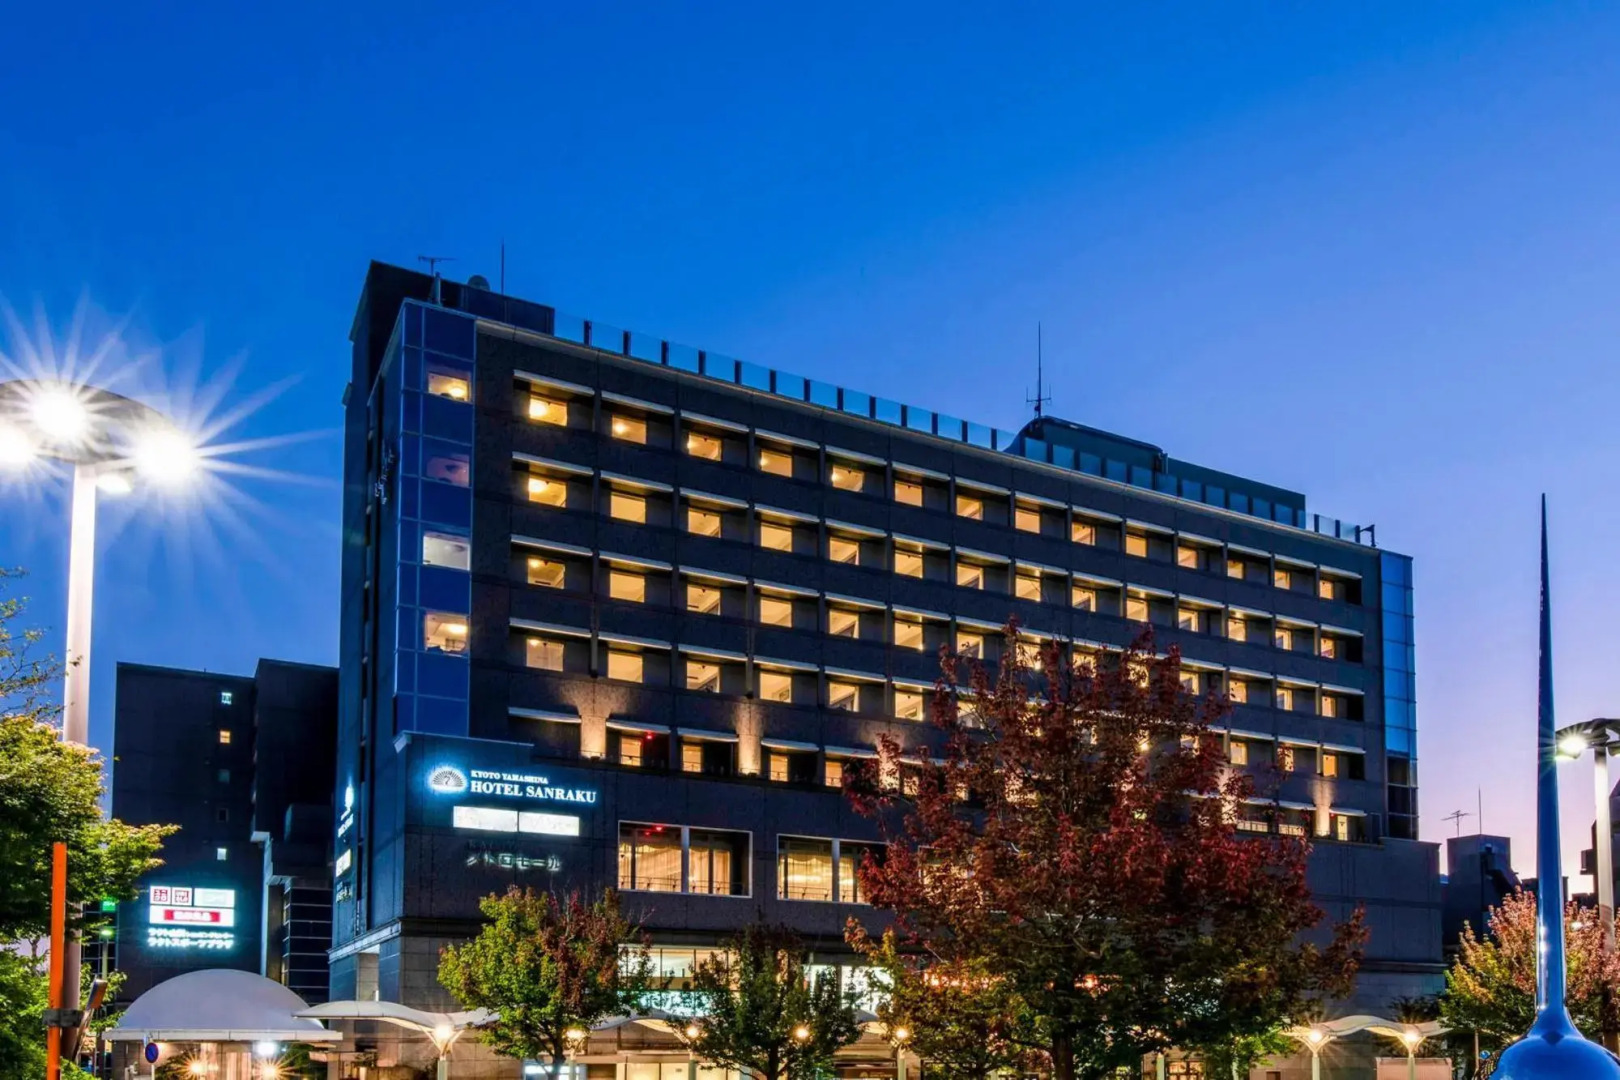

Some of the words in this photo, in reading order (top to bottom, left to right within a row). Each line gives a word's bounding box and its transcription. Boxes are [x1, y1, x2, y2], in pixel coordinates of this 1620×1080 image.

[471, 770, 500, 781] KYOTO
[501, 773, 549, 784] YAMASHINA
[470, 781, 523, 797] HOTEL
[526, 786, 597, 803] SANRAKU
